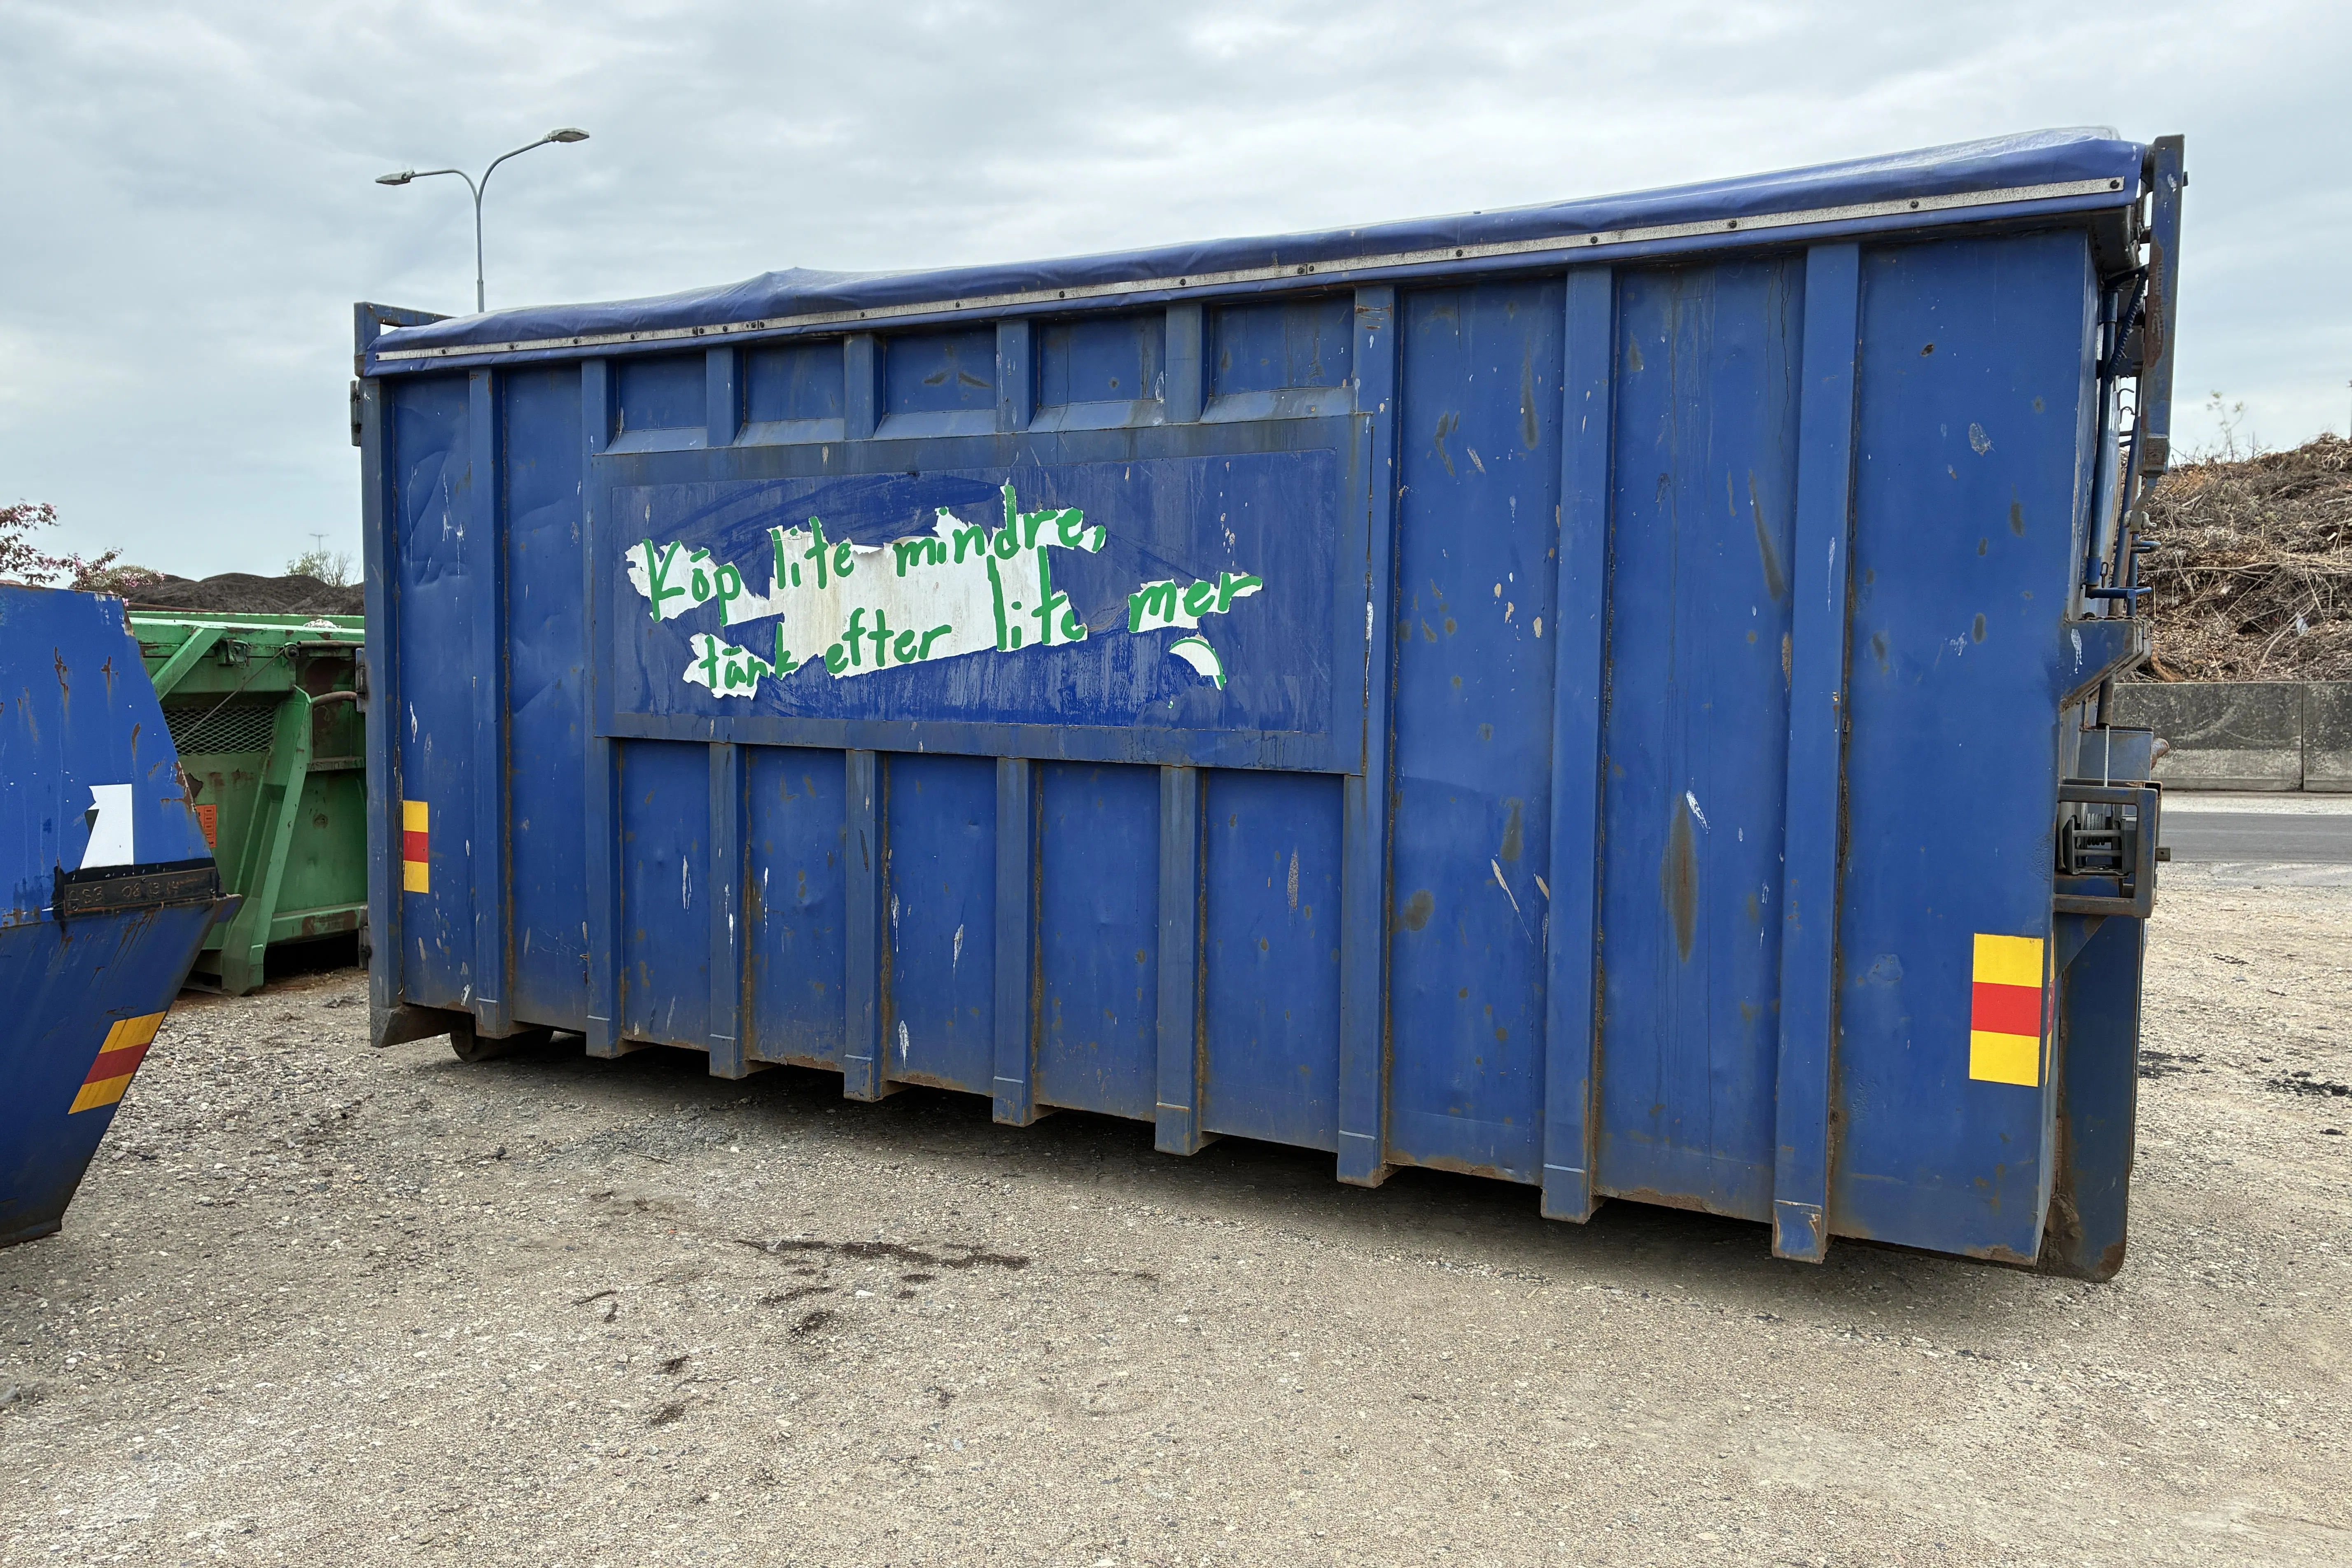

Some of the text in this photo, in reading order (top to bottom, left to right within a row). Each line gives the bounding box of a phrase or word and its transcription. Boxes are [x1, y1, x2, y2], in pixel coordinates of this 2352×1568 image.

[642, 486, 1106, 626] Köp lite mindre,
[825, 607, 952, 674] efter
[1128, 573, 1262, 632] mer
